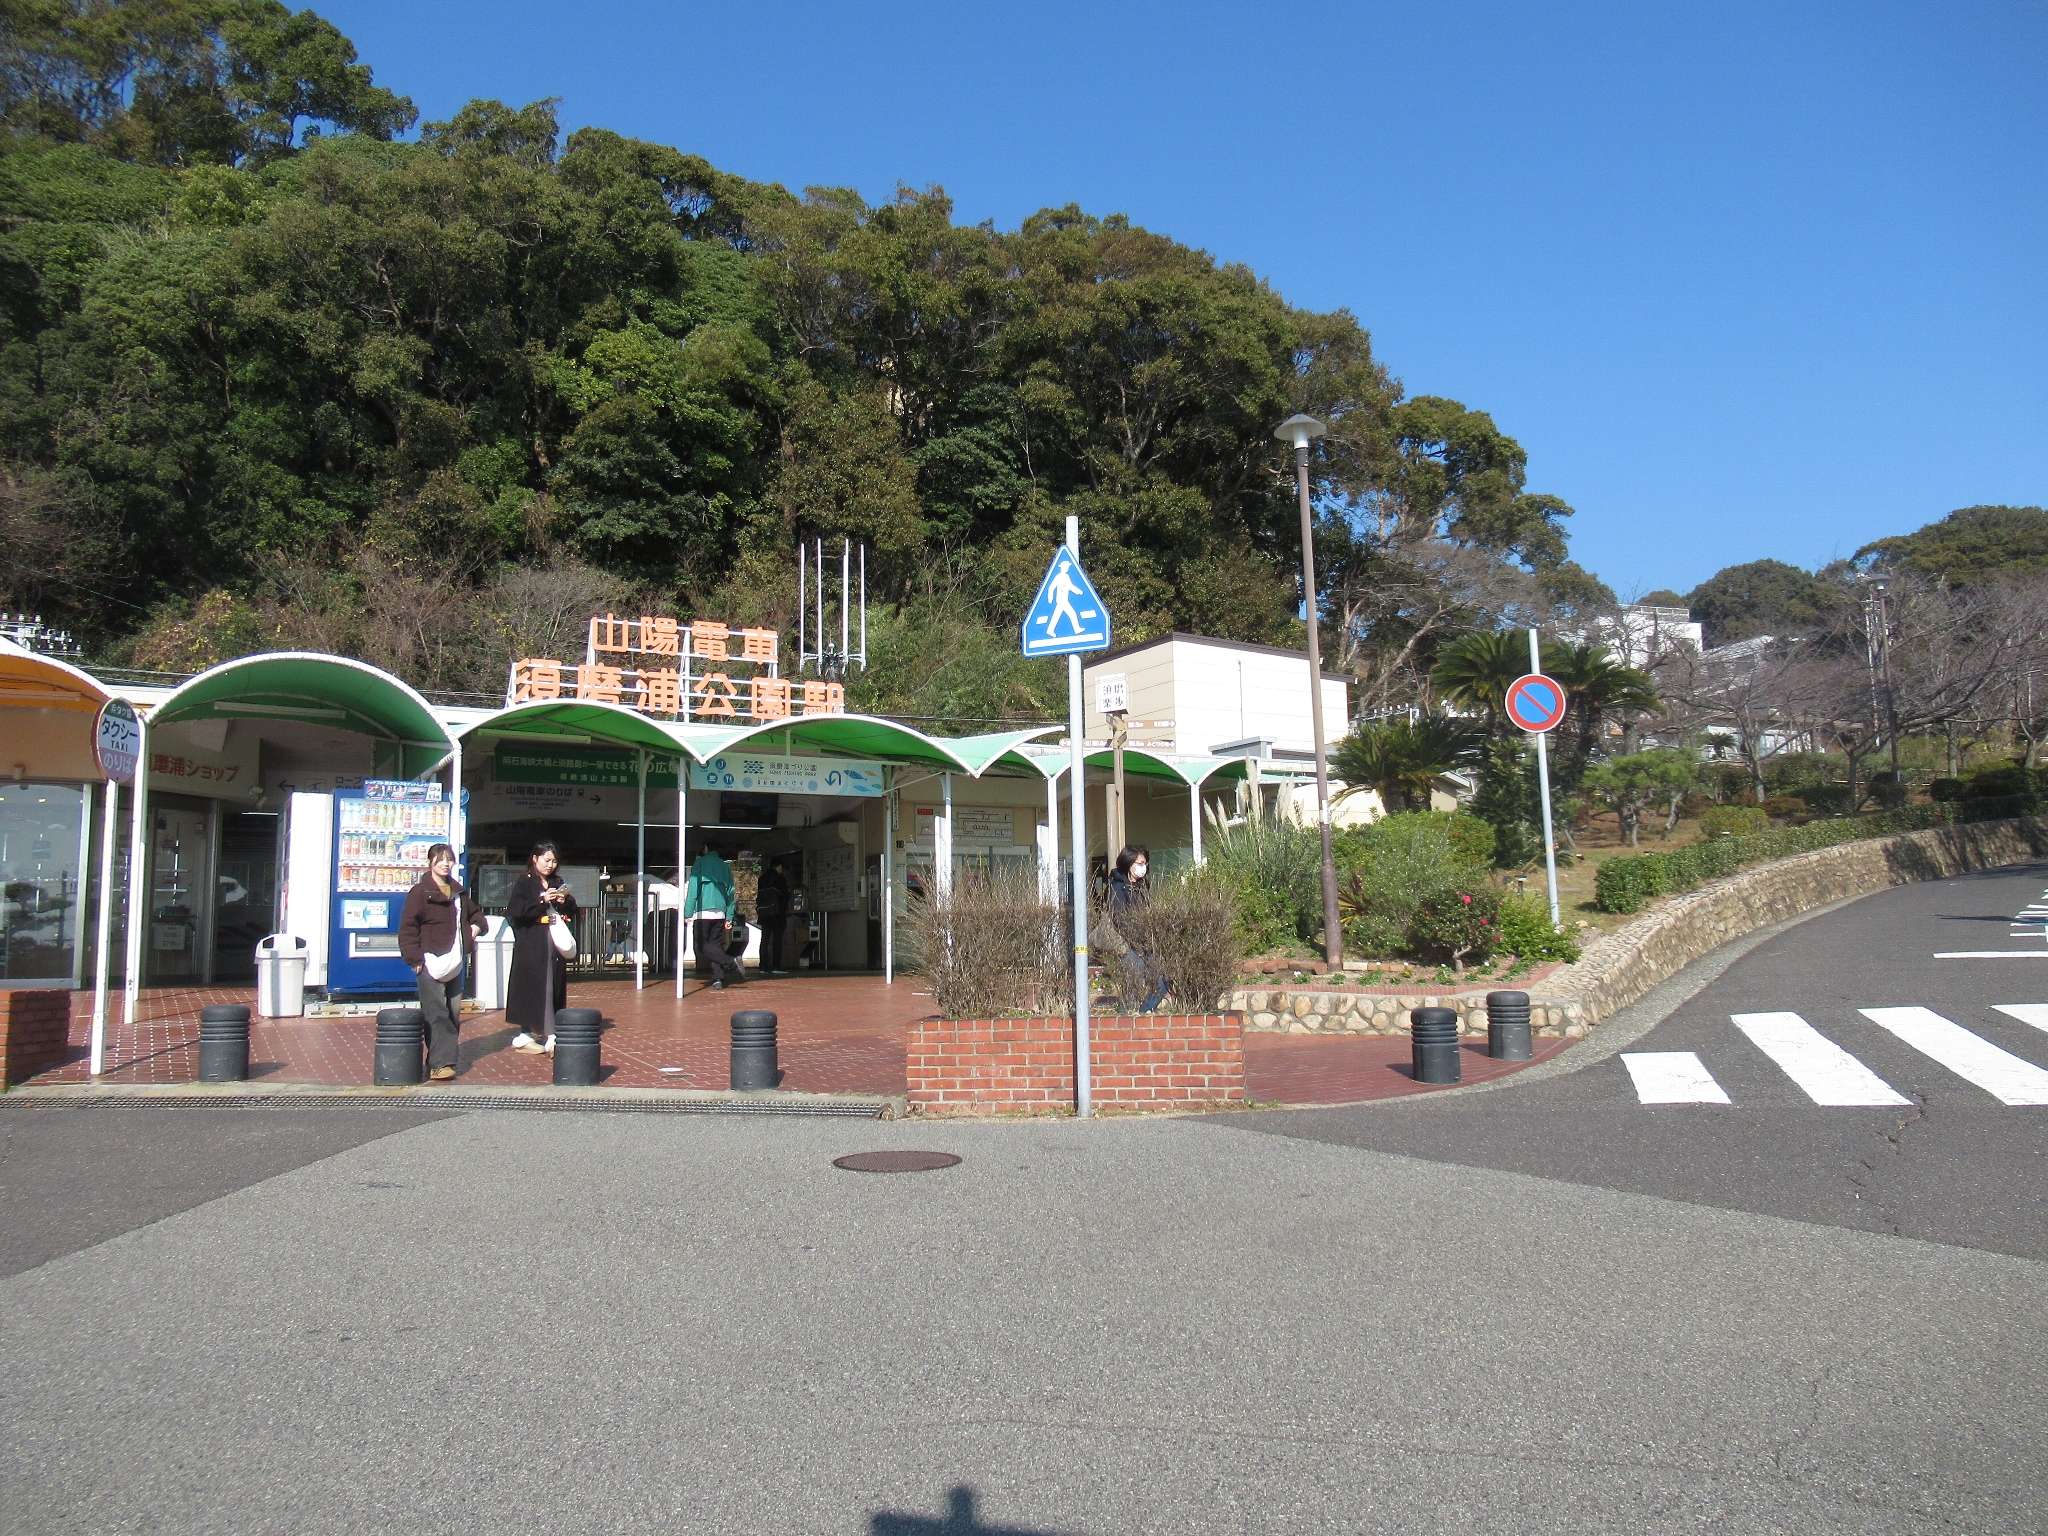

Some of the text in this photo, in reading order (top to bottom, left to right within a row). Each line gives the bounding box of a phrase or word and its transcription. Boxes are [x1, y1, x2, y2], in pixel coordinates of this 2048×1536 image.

[592, 613, 778, 664] 山陽電車
[514, 657, 845, 720] 須磨浦公園駅
[101, 717, 138, 740] タクシー
[111, 740, 128, 752] TAXI
[103, 752, 135, 776] のりば
